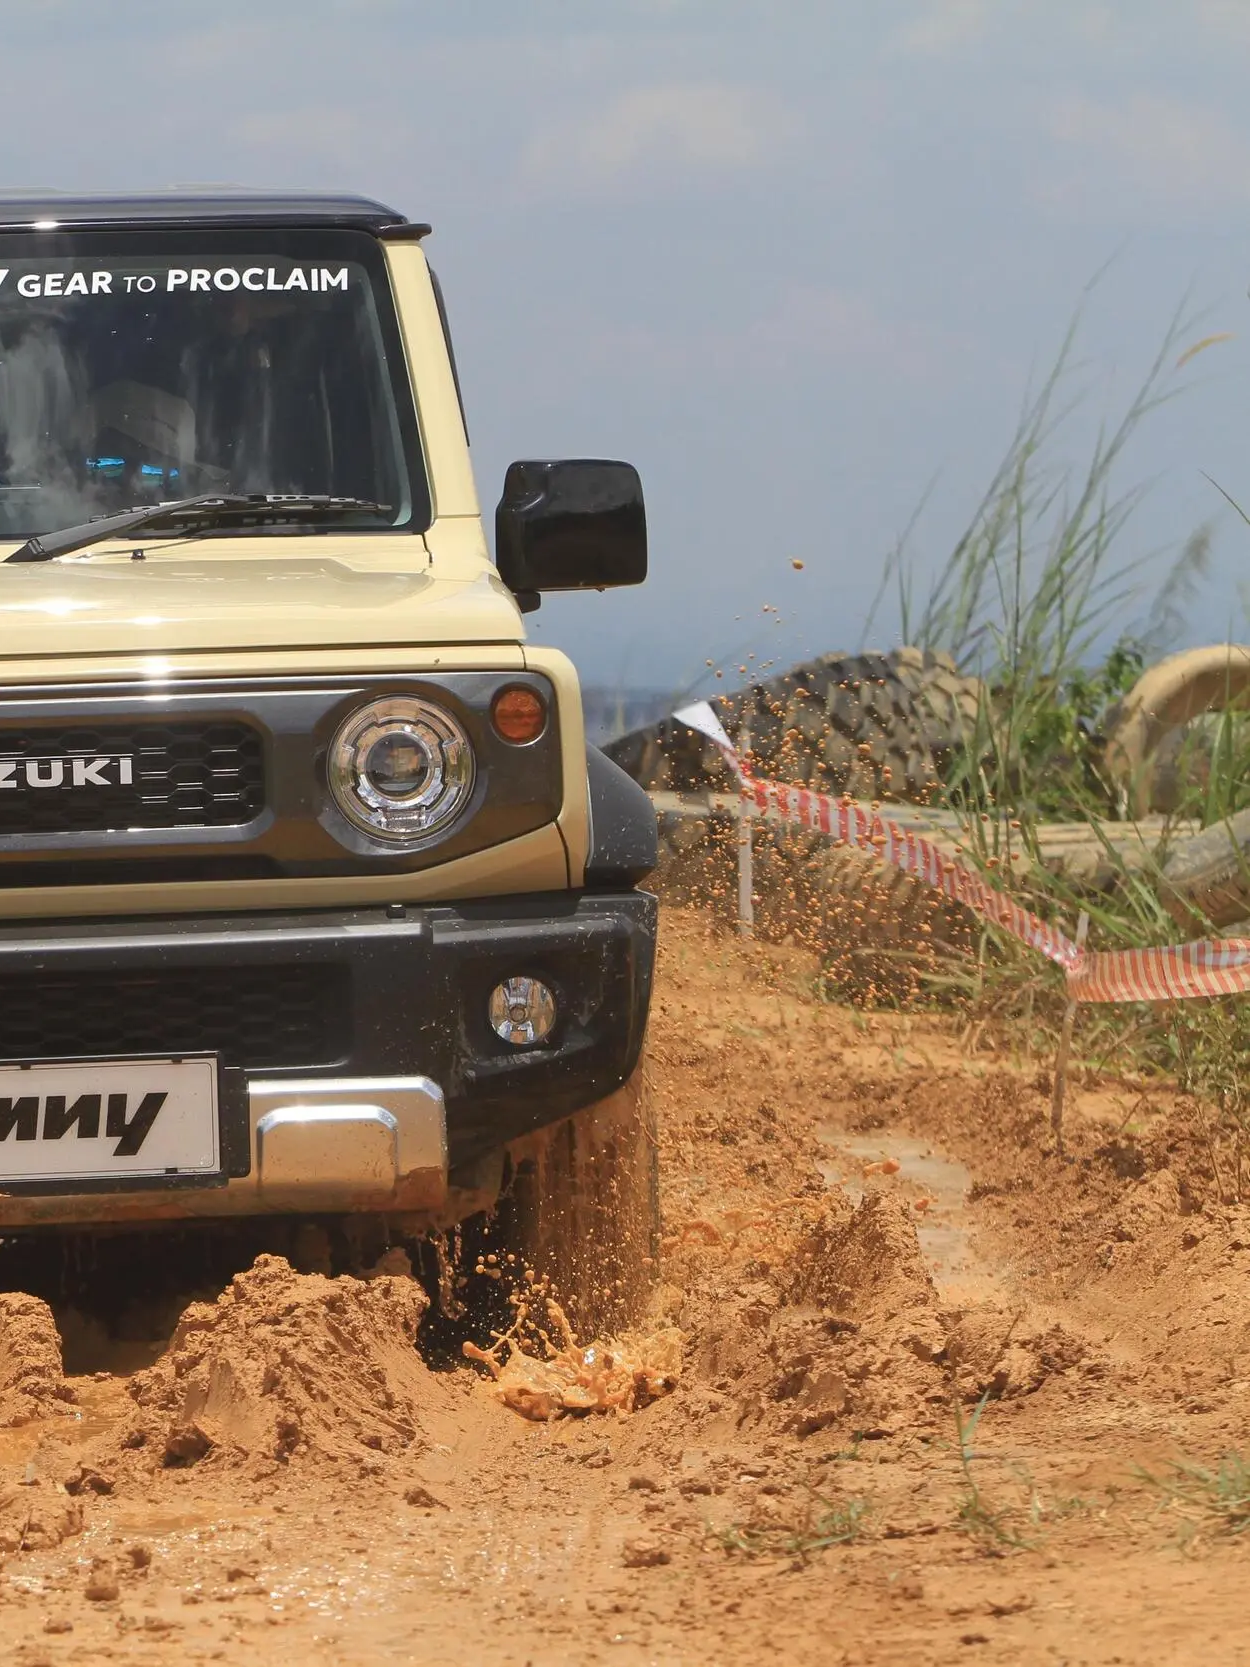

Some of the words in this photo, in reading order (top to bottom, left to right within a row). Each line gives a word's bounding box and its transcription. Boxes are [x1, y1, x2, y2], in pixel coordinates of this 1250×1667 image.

[17, 271, 113, 297] GEAR
[123, 275, 156, 293] TO
[166, 267, 349, 292] PROCLAIM
